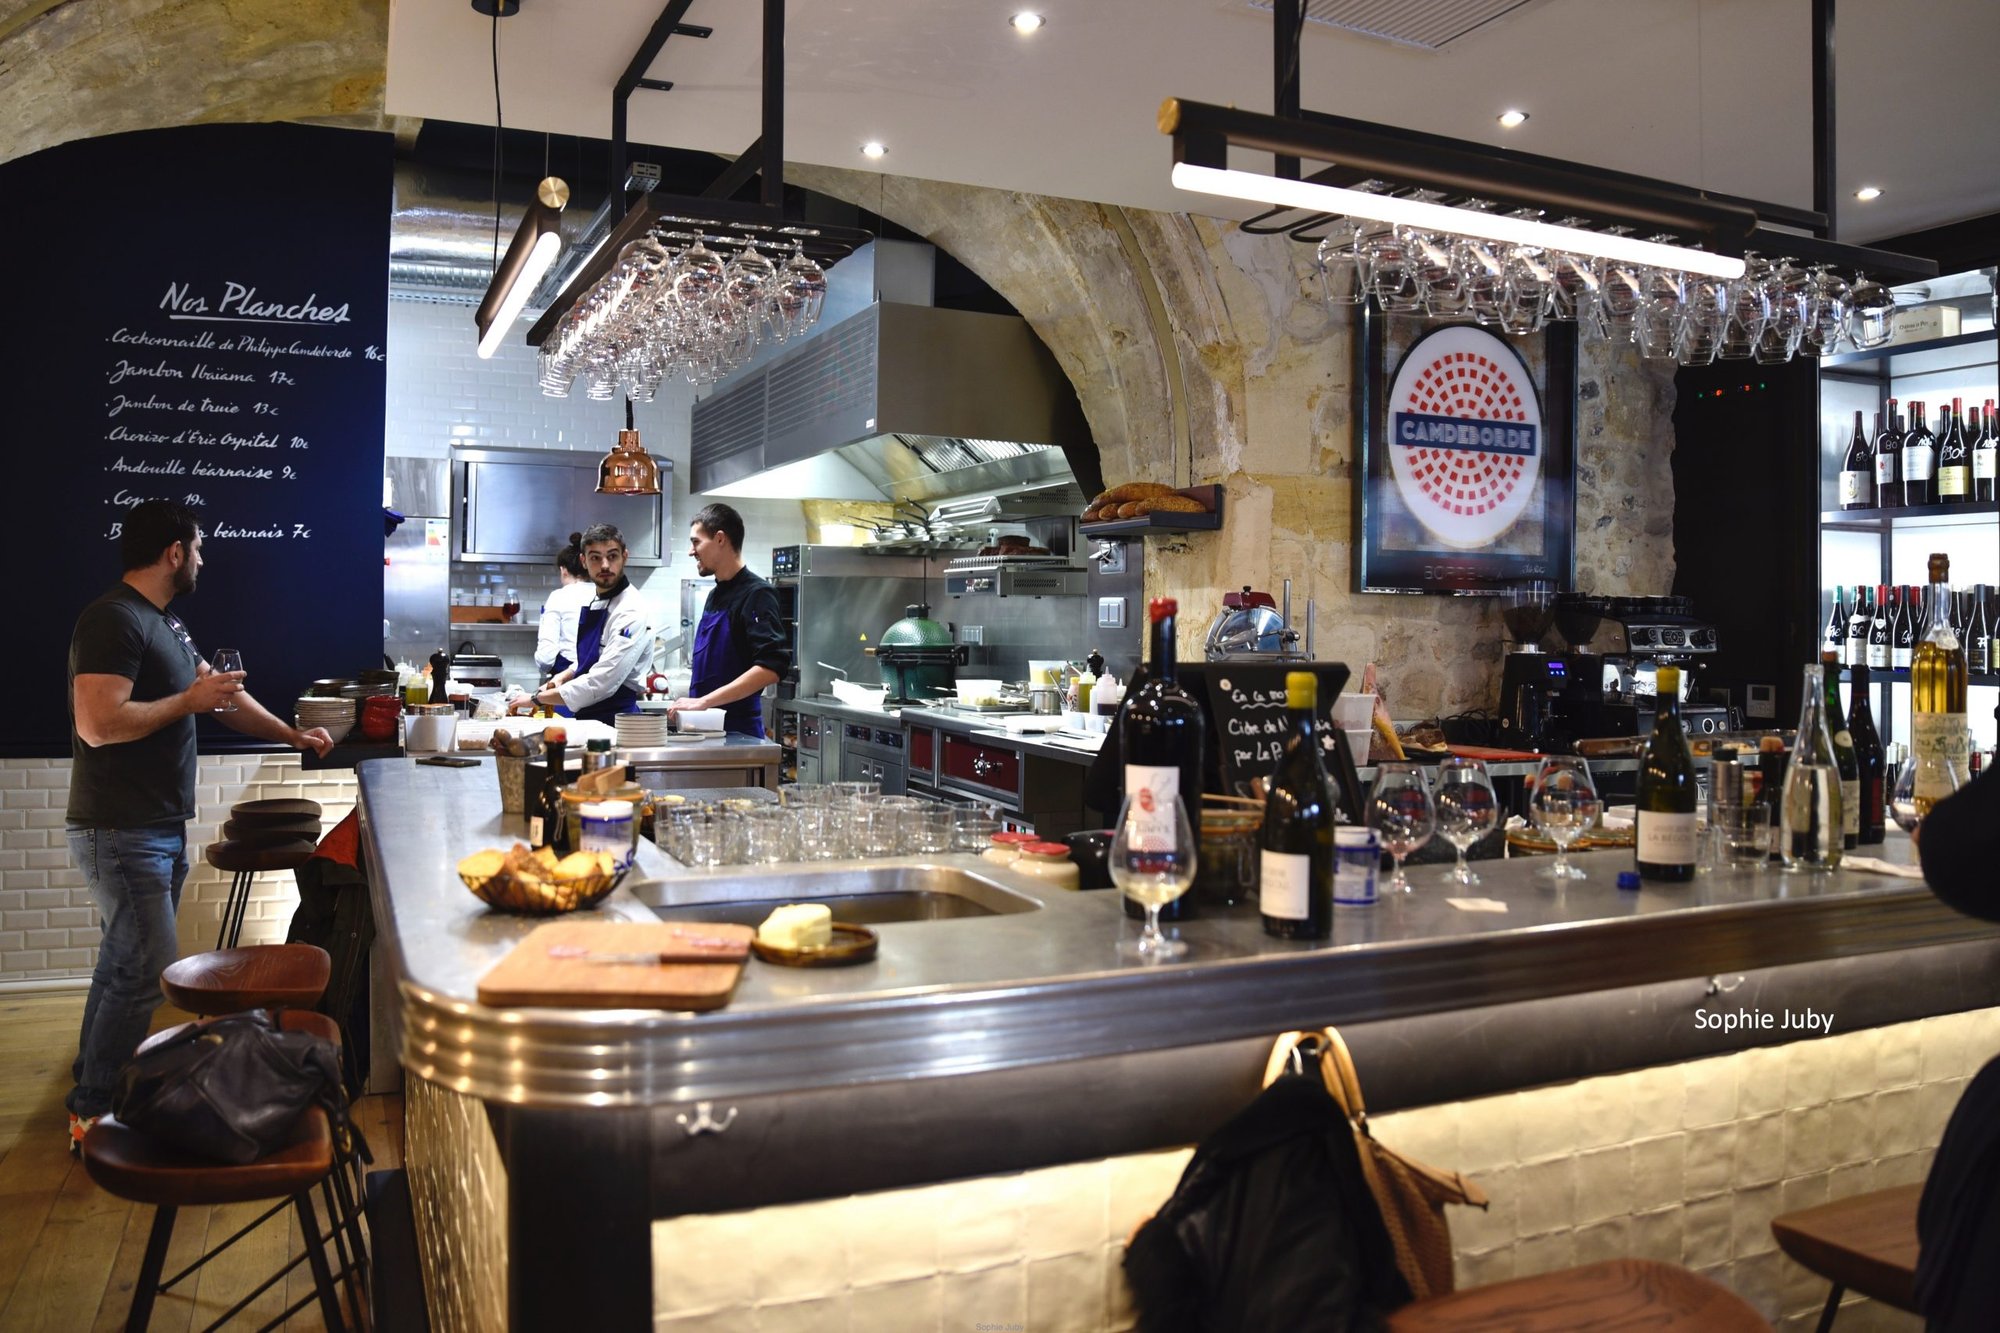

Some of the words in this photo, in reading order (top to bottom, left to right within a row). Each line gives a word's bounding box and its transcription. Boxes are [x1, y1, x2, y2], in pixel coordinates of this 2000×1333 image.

[160, 281, 208, 313] Nos
[219, 281, 351, 323] Planches
[112, 328, 216, 349] Cochonnaille
[218, 339, 234, 350] de
[237, 335, 287, 359] Philippe
[109, 360, 183, 384] Jambon
[109, 394, 173, 417] Jambon
[178, 400, 195, 412] de
[200, 397, 240, 414] truie
[109, 426, 170, 443] Chorizo
[220, 432, 279, 451] Ospital
[1402, 420, 1531, 450] CAMDEBORDE
[111, 456, 186, 475] Andouille
[192, 460, 273, 479] béarnaise
[213, 522, 284, 538] béarnais
[1228, 718, 1261, 736] Cidre
